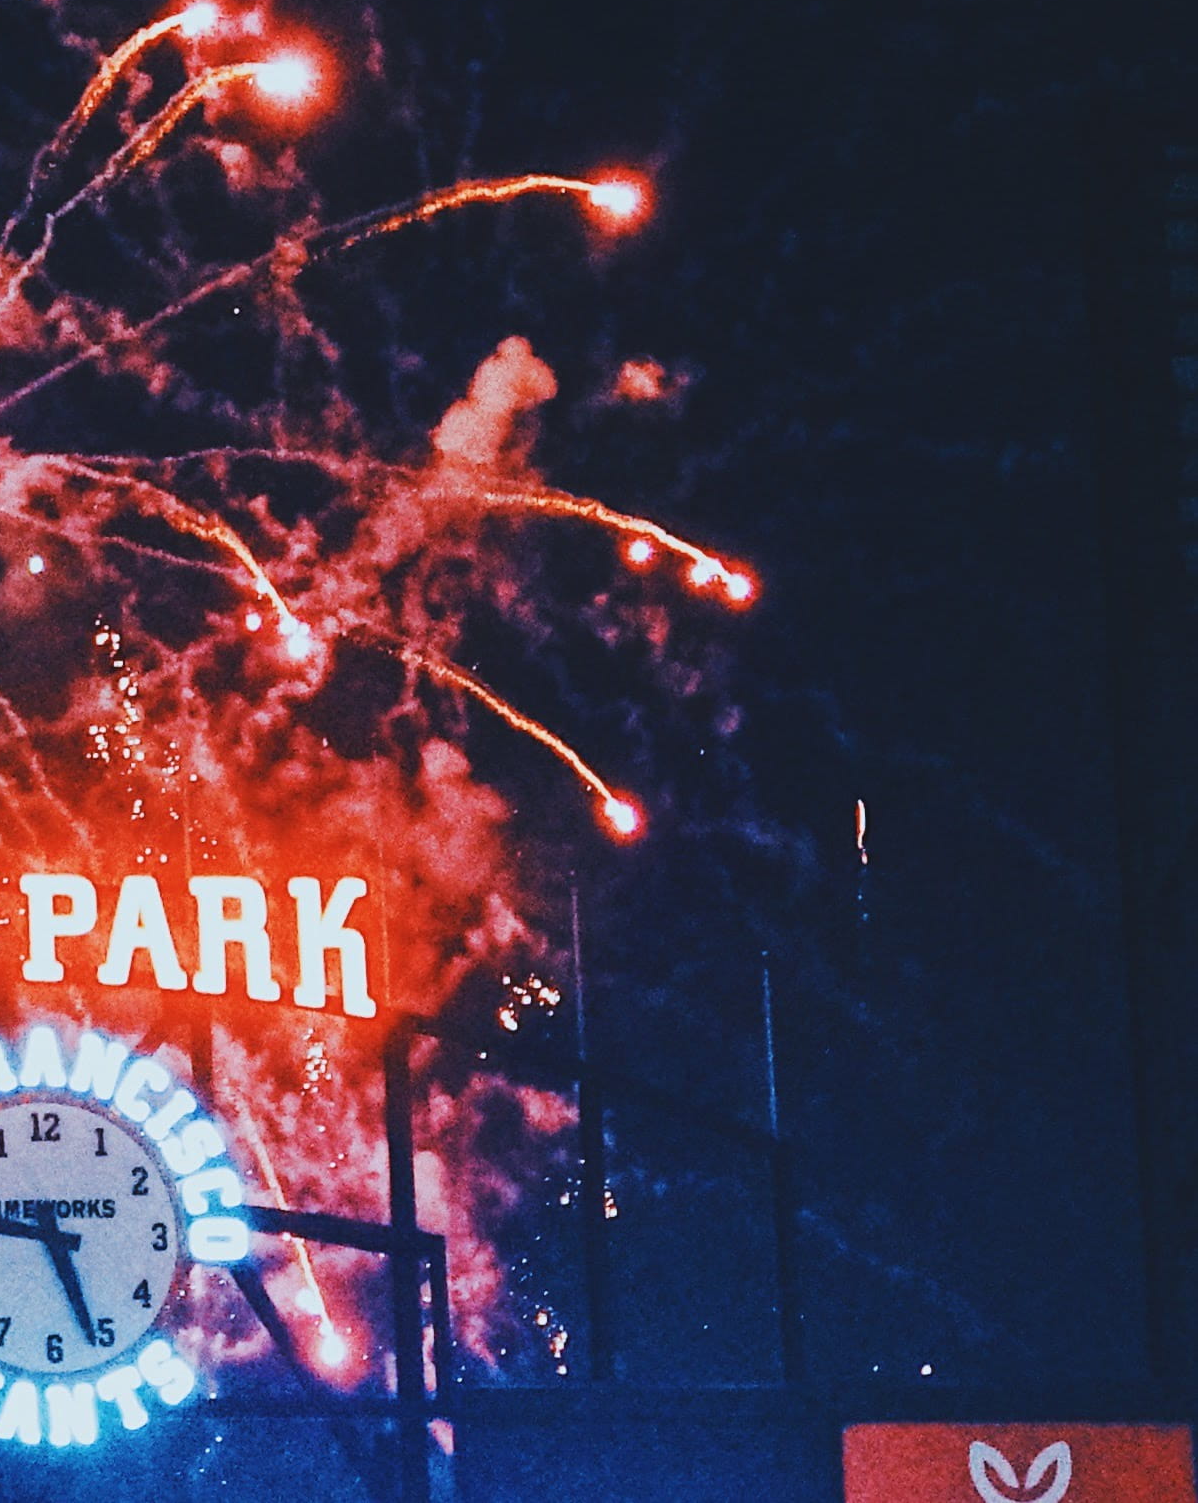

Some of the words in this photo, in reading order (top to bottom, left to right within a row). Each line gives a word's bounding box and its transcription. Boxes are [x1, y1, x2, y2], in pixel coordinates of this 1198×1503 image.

[19, 874, 377, 1019] PARK
[30, 1112, 61, 1142] 12
[94, 1127, 108, 1156] 1
[131, 1167, 149, 1196] 2
[152, 1223, 168, 1251] 3
[133, 1279, 151, 1308] 4
[97, 1319, 115, 1347] 5
[47, 1334, 63, 1363] 6
